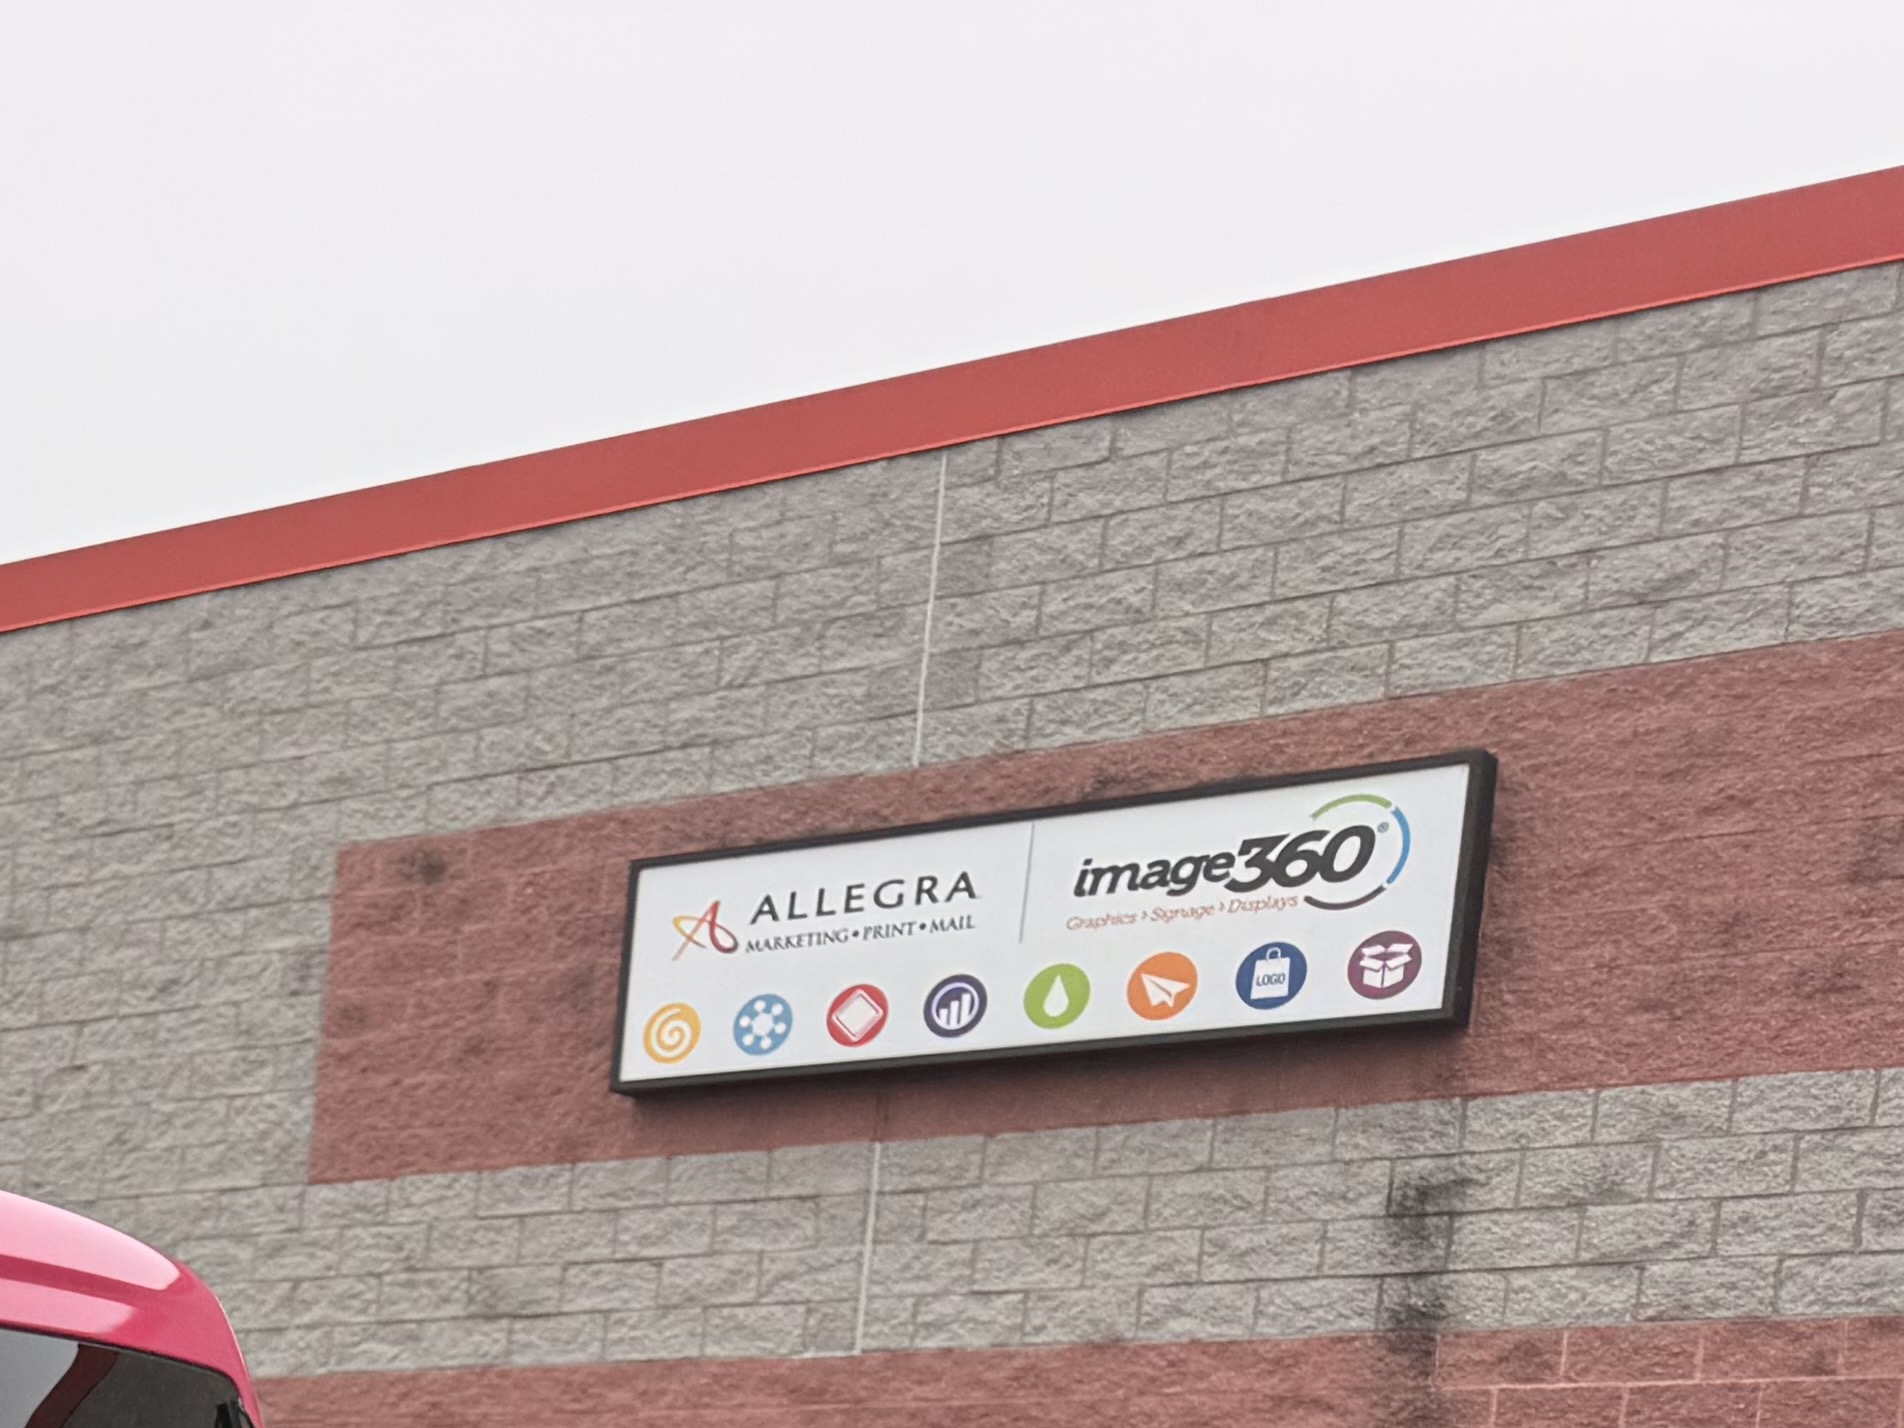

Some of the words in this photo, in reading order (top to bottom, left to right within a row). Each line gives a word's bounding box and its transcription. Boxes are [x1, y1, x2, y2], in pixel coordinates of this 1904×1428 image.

[749, 871, 979, 925] ALLEGRA
[1066, 910, 1137, 931] Graphics
[1150, 904, 1215, 924] Signage
[1228, 894, 1298, 915] Displays
[1256, 973, 1286, 986] LOGO
